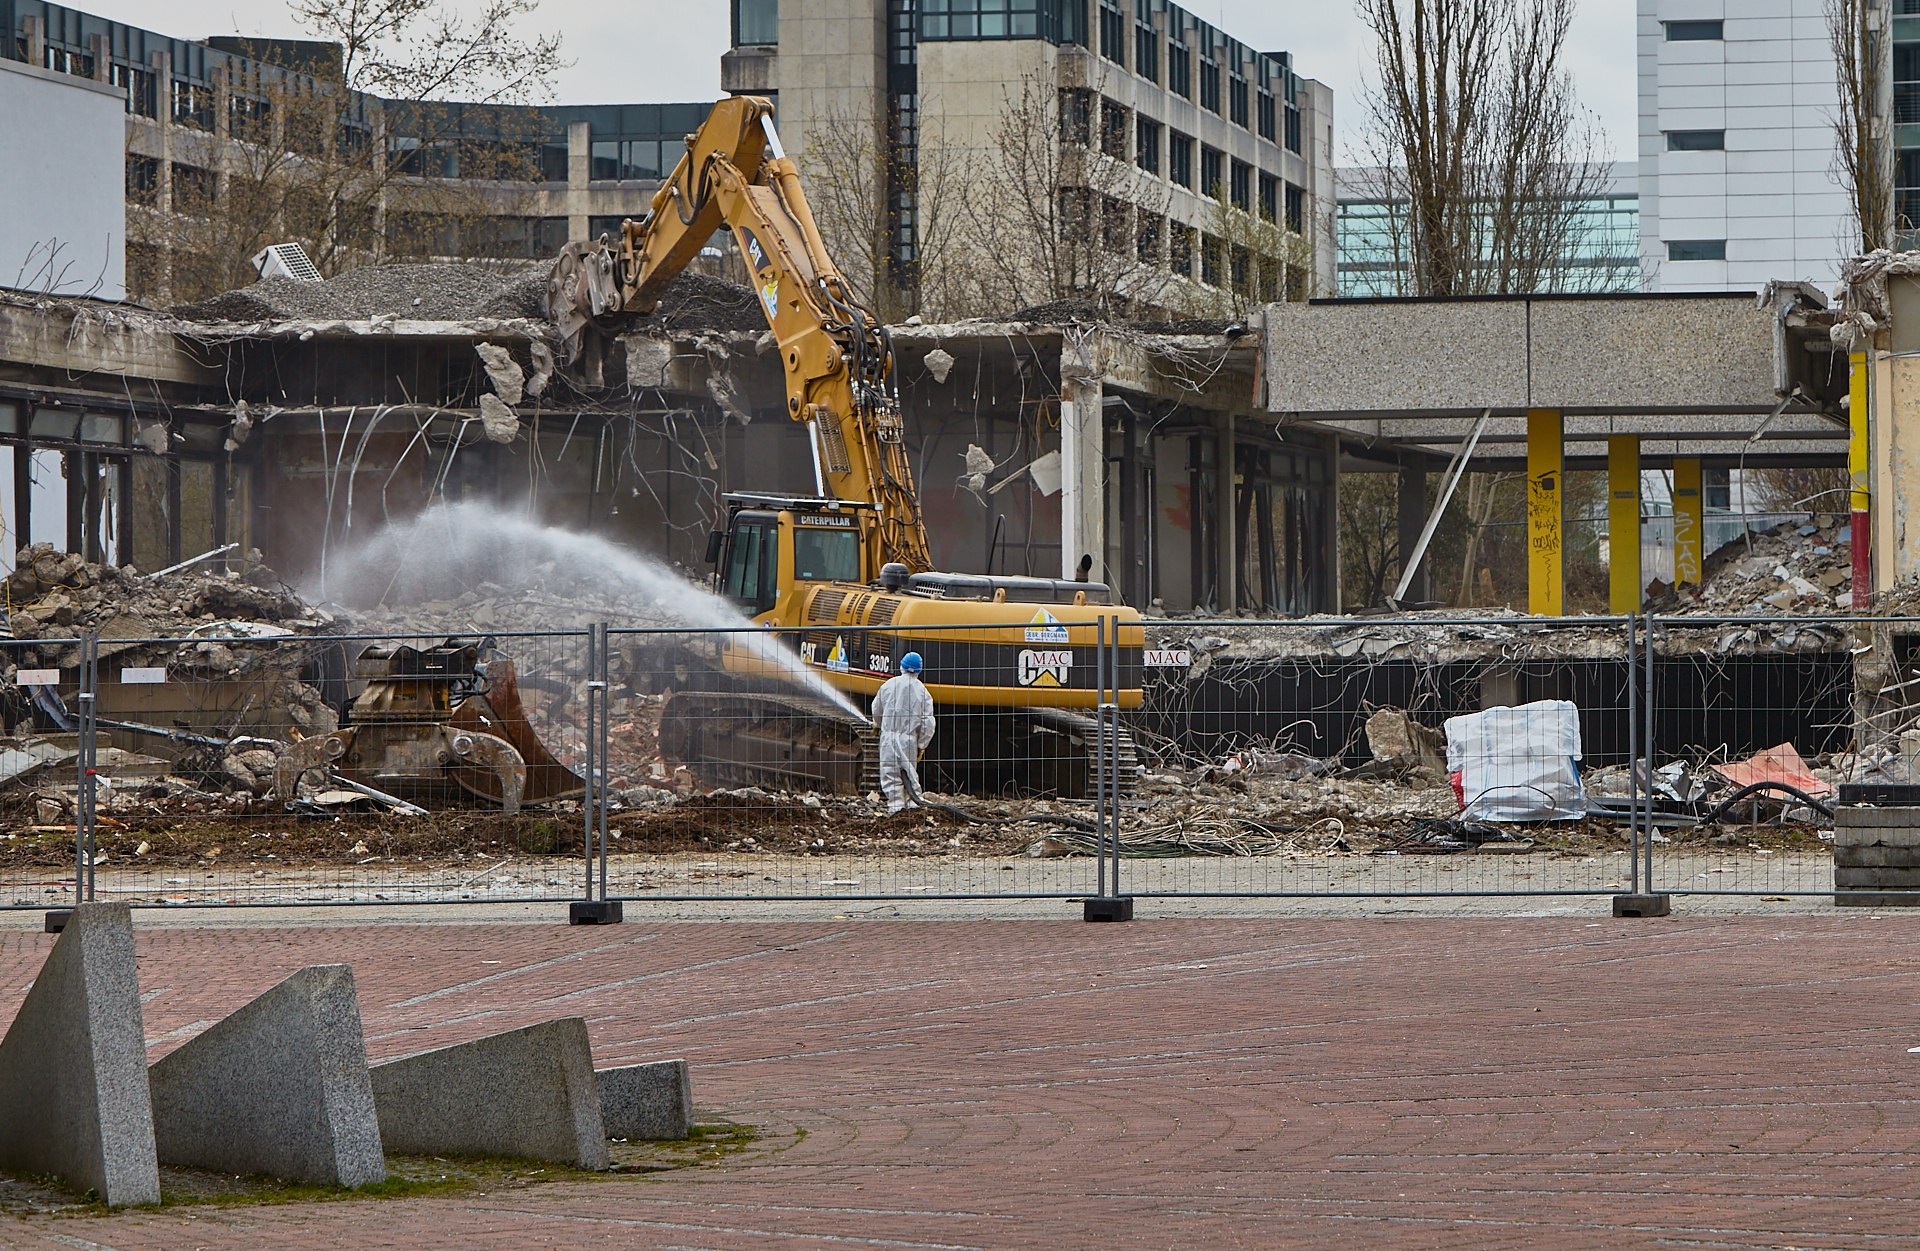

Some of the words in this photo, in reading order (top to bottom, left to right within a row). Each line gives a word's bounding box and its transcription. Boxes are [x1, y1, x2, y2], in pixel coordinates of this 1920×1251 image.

[749, 238, 762, 267] CAT
[801, 515, 850, 526] CATERPILLAR
[801, 641, 816, 664] CAT
[1032, 652, 1070, 665] MAC
[1149, 651, 1187, 664] MAC
[869, 653, 890, 673] 330C
